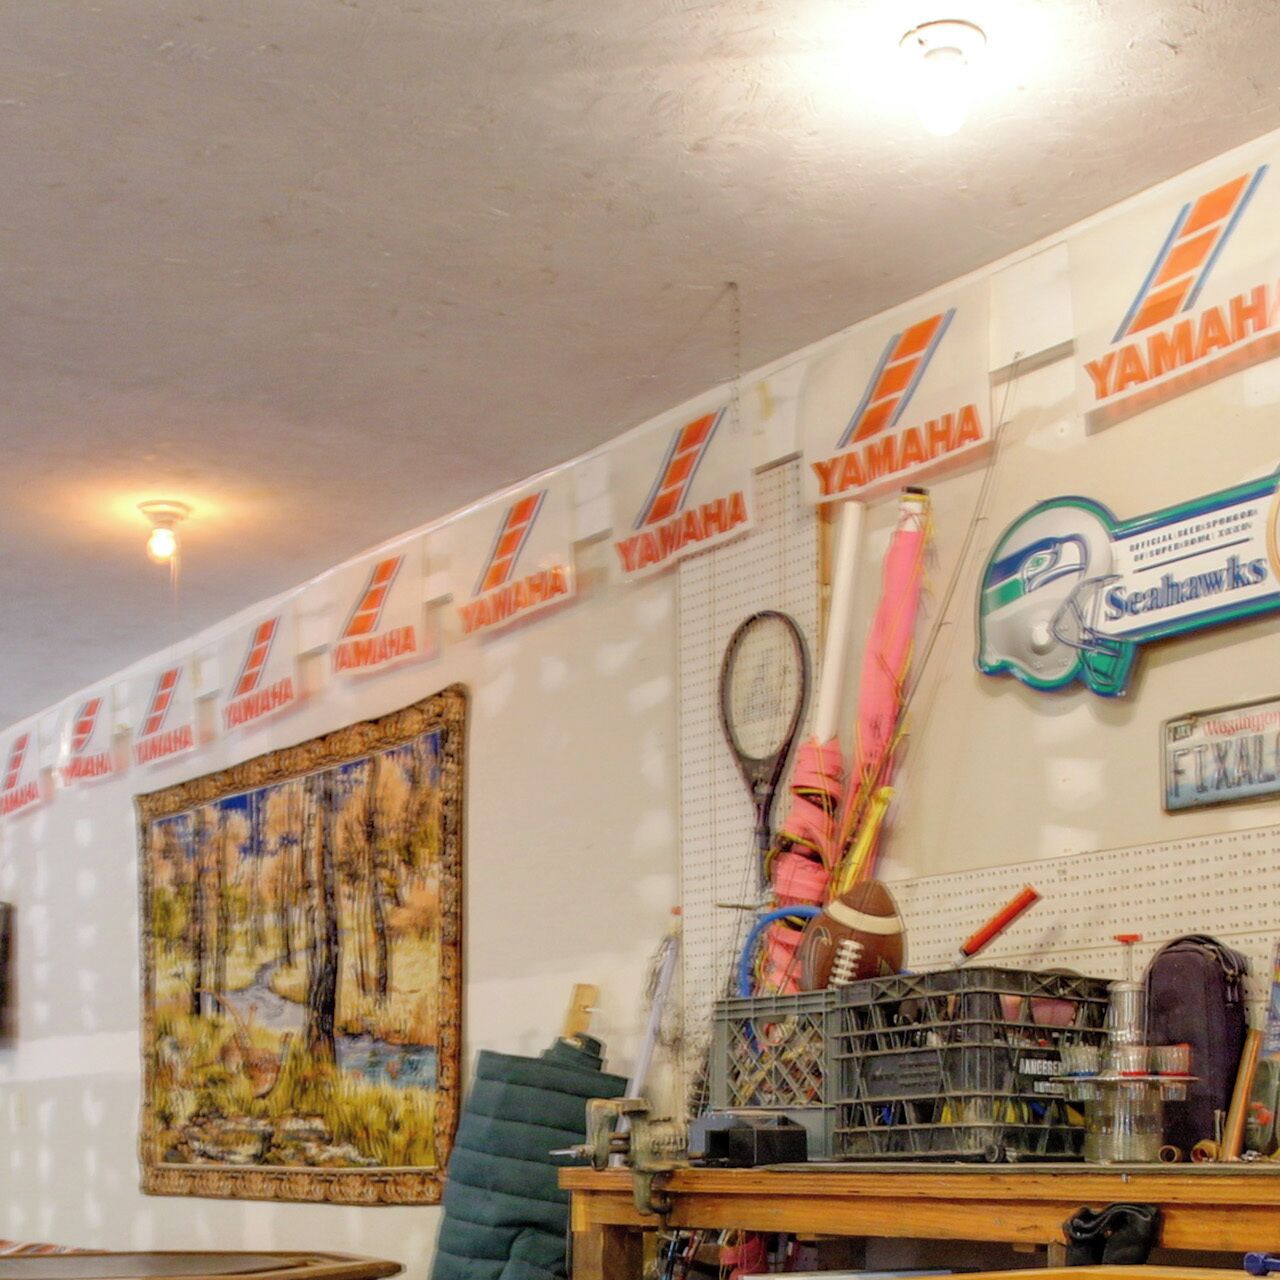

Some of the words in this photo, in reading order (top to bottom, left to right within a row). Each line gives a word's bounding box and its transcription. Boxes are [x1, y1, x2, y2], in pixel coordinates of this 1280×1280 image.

[813, 404, 984, 495] YAMAHA
[616, 489, 748, 573] YAMAHA
[1130, 533, 1173, 552] OFFICIAL
[1206, 508, 1258, 529] SPONSOR
[1150, 543, 1181, 558] SUPER
[459, 564, 570, 634] YAMAHA
[1105, 554, 1268, 622] Seahawks
[332, 625, 417, 673] YAMAHA
[223, 676, 295, 731] YAMAHA
